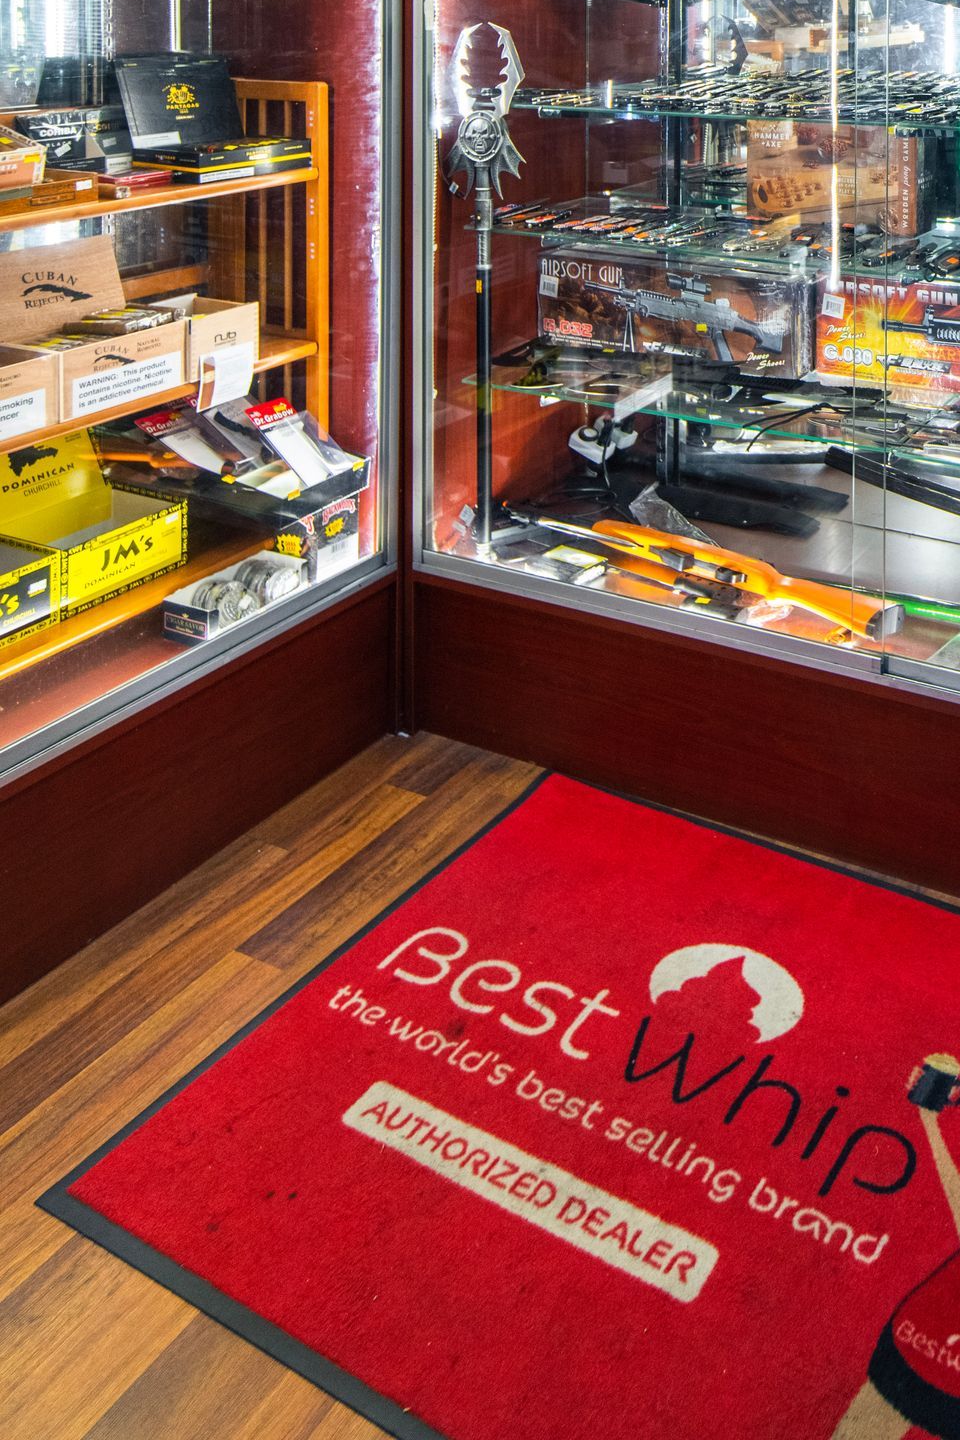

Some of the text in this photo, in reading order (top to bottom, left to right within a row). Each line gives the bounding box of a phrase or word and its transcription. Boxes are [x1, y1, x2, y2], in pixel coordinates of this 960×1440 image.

[21, 270, 78, 287] CUBAN
[541, 258, 624, 285] AIRSOFT GUN
[24, 294, 65, 310] REJECTS
[916, 289, 959, 306] GUN
[214, 330, 238, 343] nub
[78, 360, 167, 390] WARNING: This product
[78, 386, 111, 400] contains
[144, 368, 173, 381] Nicotine
[78, 400, 85, 409] is
[86, 397, 98, 406] an
[98, 386, 132, 403] addictive
[2, 463, 75, 494] DOMINICAN
[23, 479, 63, 498] CHURCHILL
[101, 535, 154, 572] JM's
[84, 562, 136, 590] DOMINICAN
[376, 926, 620, 1060] Best
[328, 984, 890, 1266] the world's best selling brand
[360, 1100, 701, 1285] AUTHORIZED DEALER
